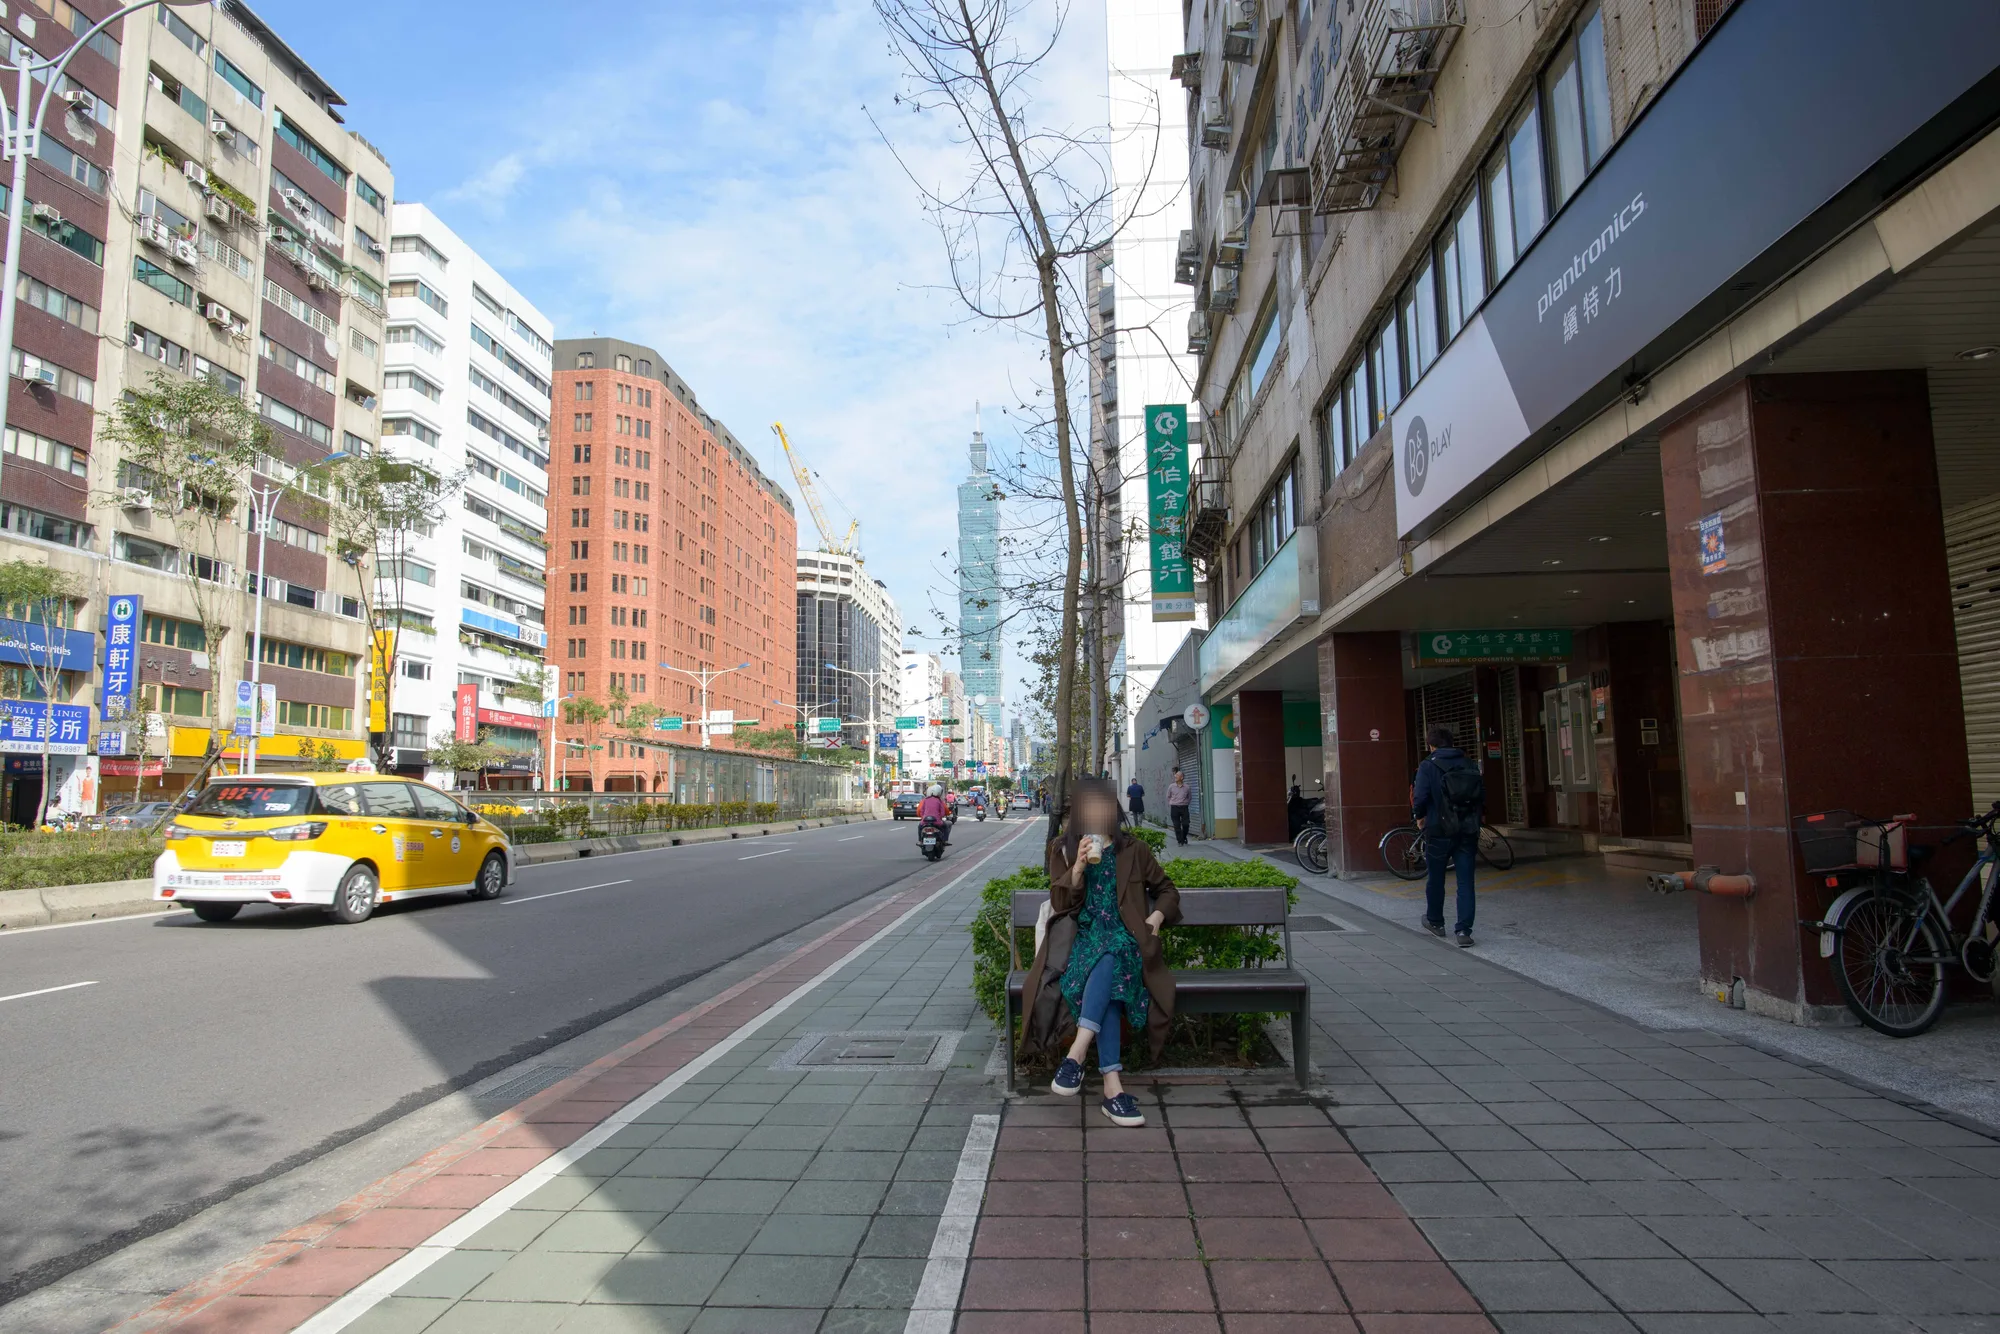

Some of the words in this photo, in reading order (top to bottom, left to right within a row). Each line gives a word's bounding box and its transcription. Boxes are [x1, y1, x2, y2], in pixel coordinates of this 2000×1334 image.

[1562, 266, 1622, 345] 繽特力
[1430, 423, 1451, 462] PLAY
[1456, 633, 1560, 644] 合作金庫銀行
[106, 623, 131, 718] 康軒牙醫
[46, 744, 81, 753] 709-9987
